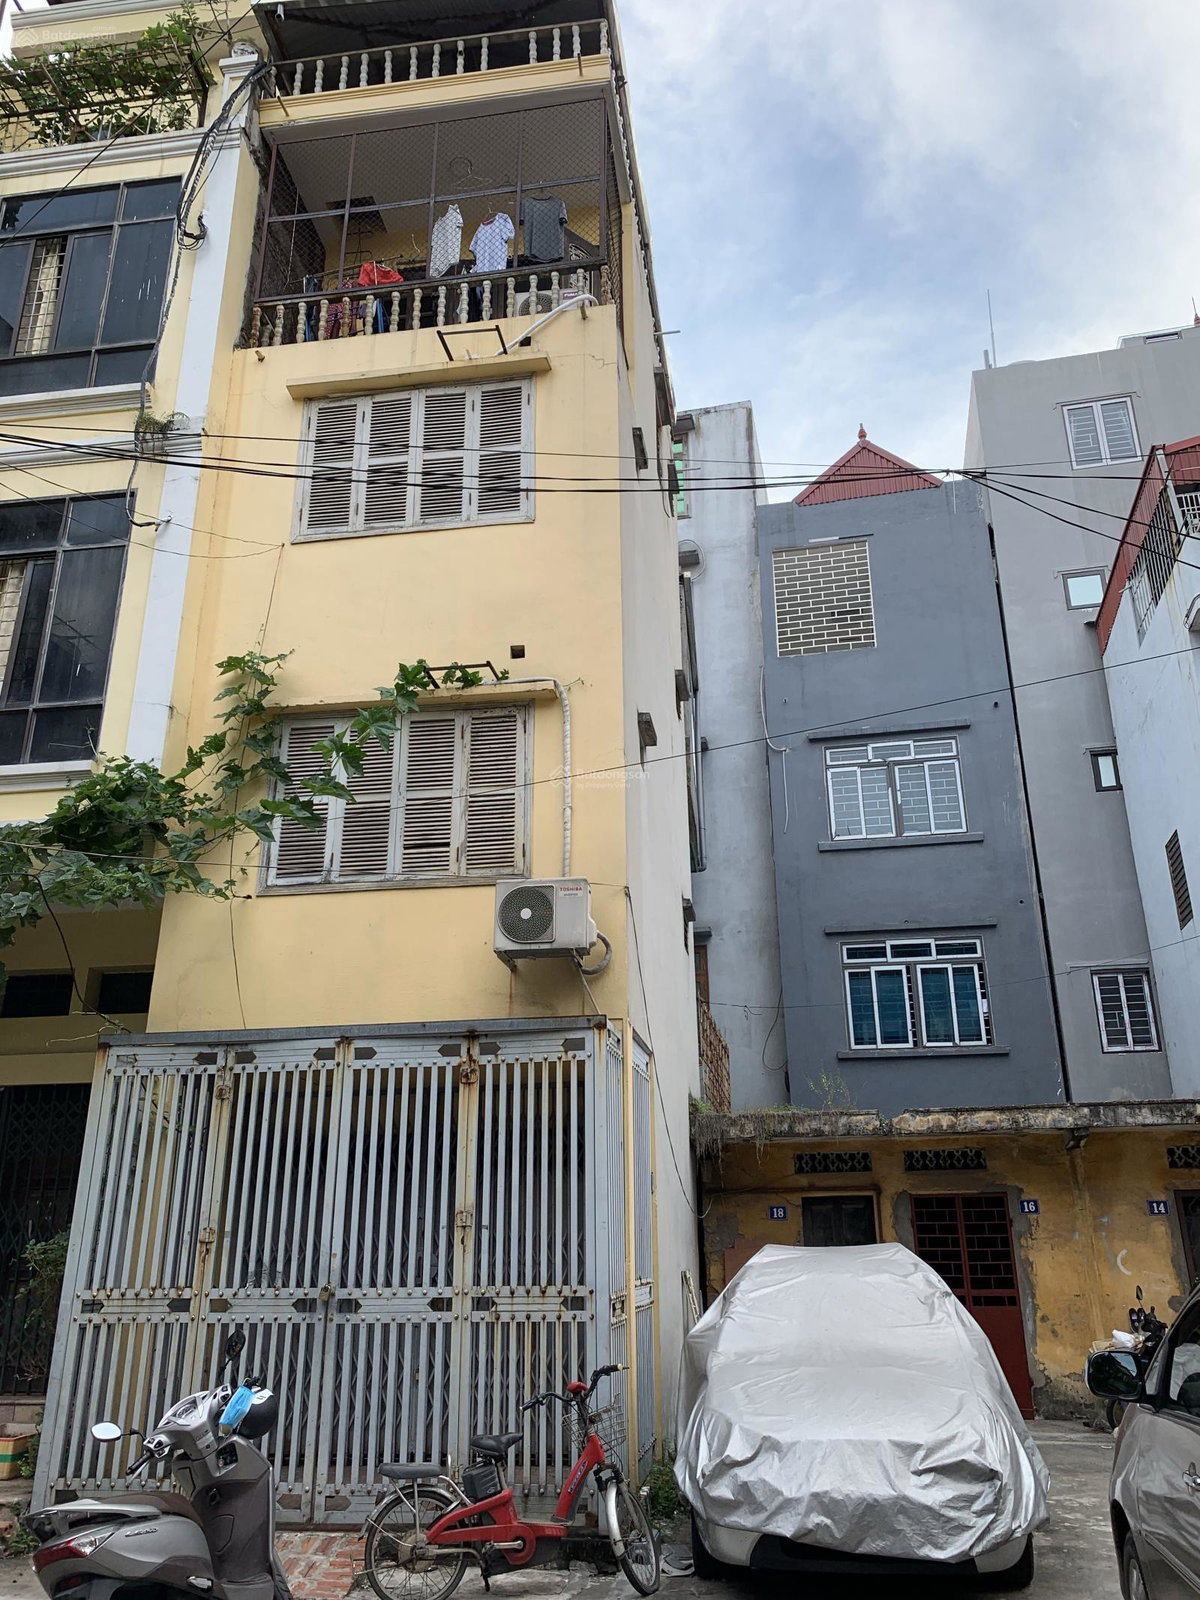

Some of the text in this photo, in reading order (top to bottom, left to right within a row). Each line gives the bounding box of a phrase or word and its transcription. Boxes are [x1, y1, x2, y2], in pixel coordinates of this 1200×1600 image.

[1023, 1201, 1036, 1212] 16
[1152, 1202, 1166, 1213] 14
[773, 1207, 784, 1218] 18
